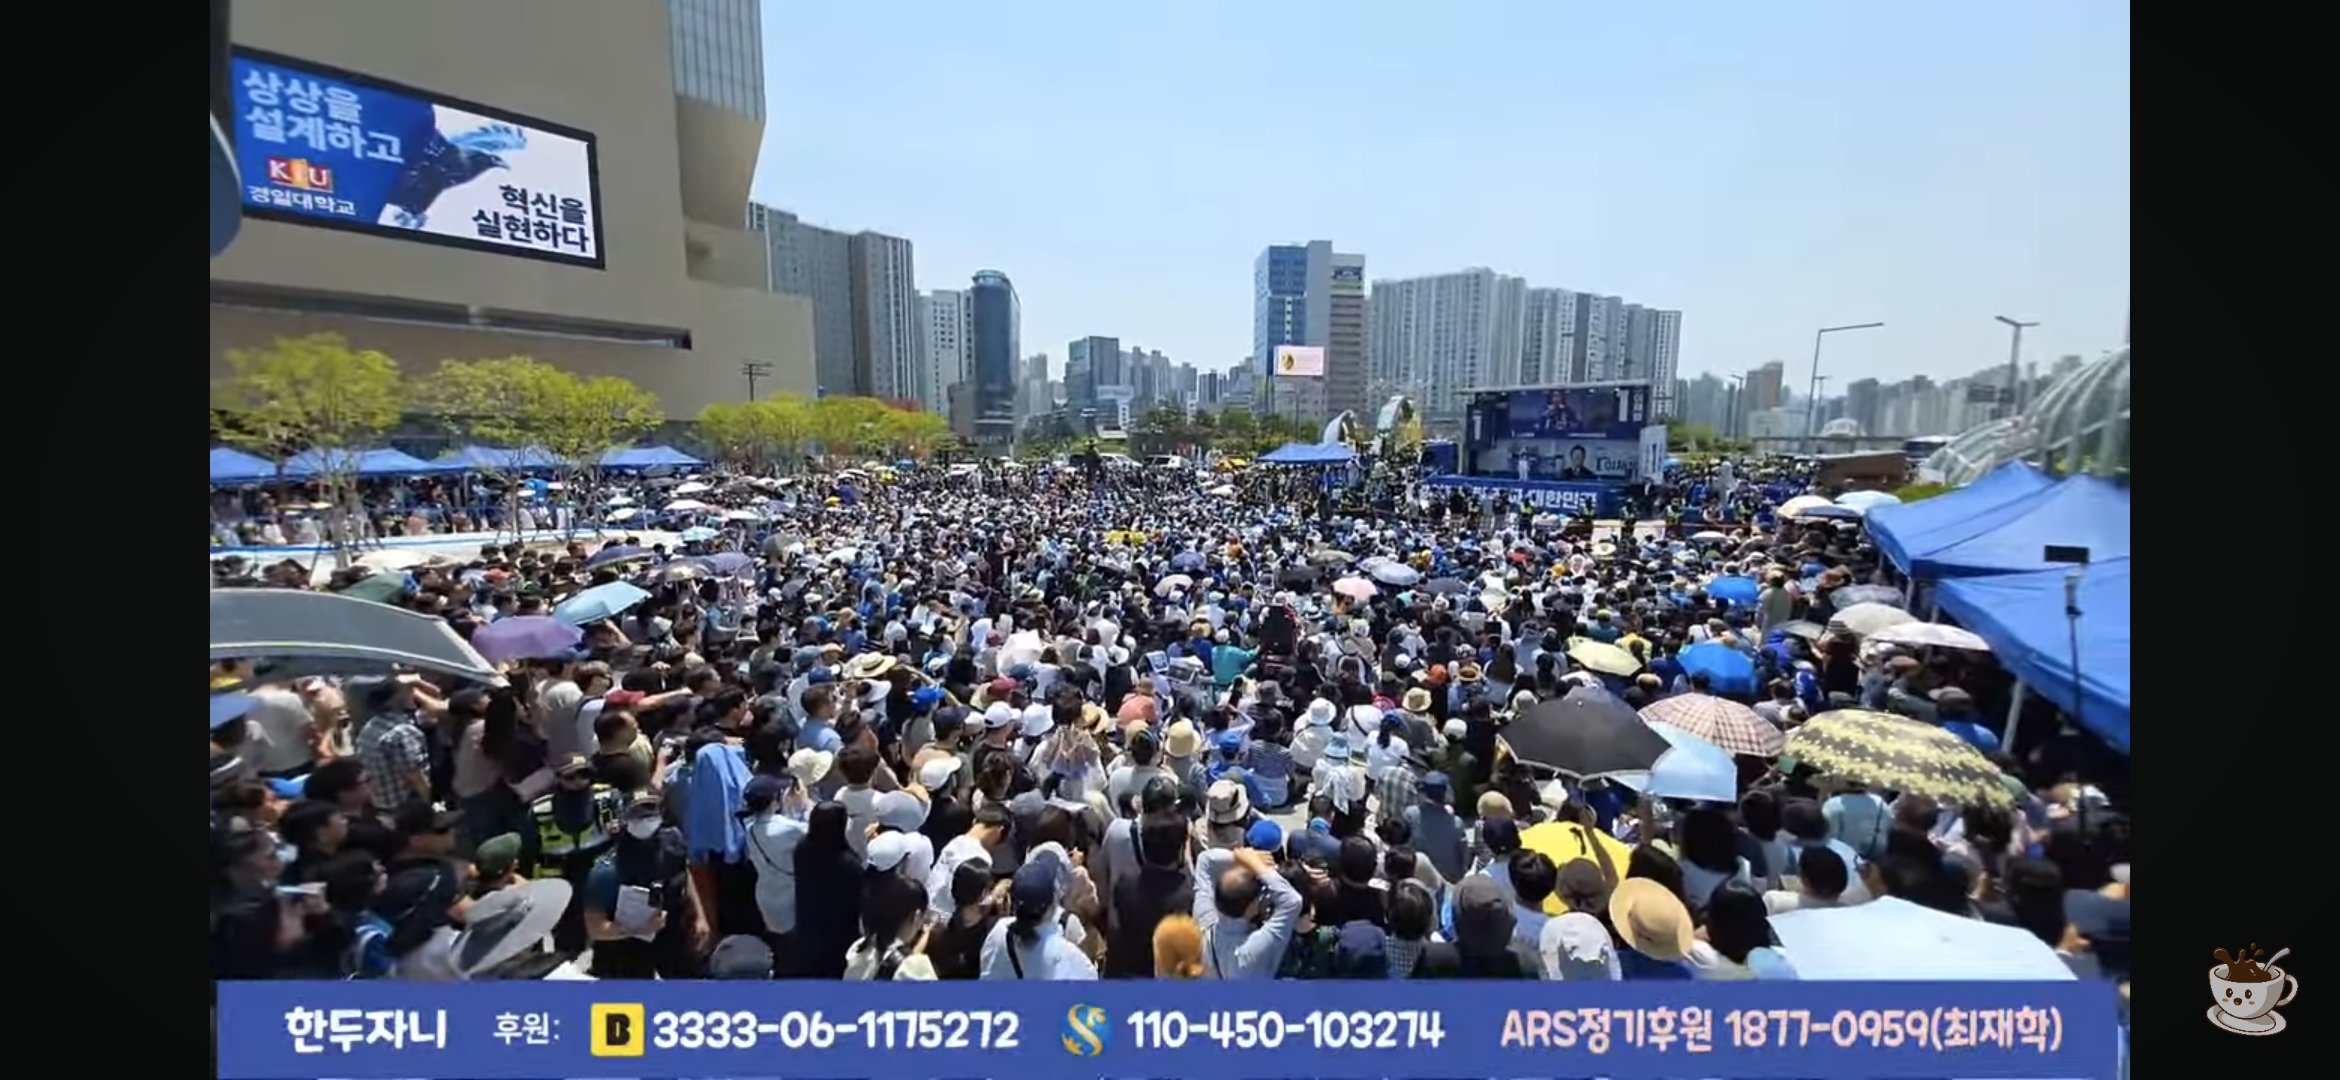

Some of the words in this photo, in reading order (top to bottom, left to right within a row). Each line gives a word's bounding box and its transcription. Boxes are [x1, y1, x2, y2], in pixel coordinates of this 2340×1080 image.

[244, 70, 362, 123] 상상을
[247, 106, 404, 164] 설계하고
[247, 186, 356, 215] 경일대학교
[499, 183, 585, 226] 혁신을
[472, 208, 590, 253] 실현하다
